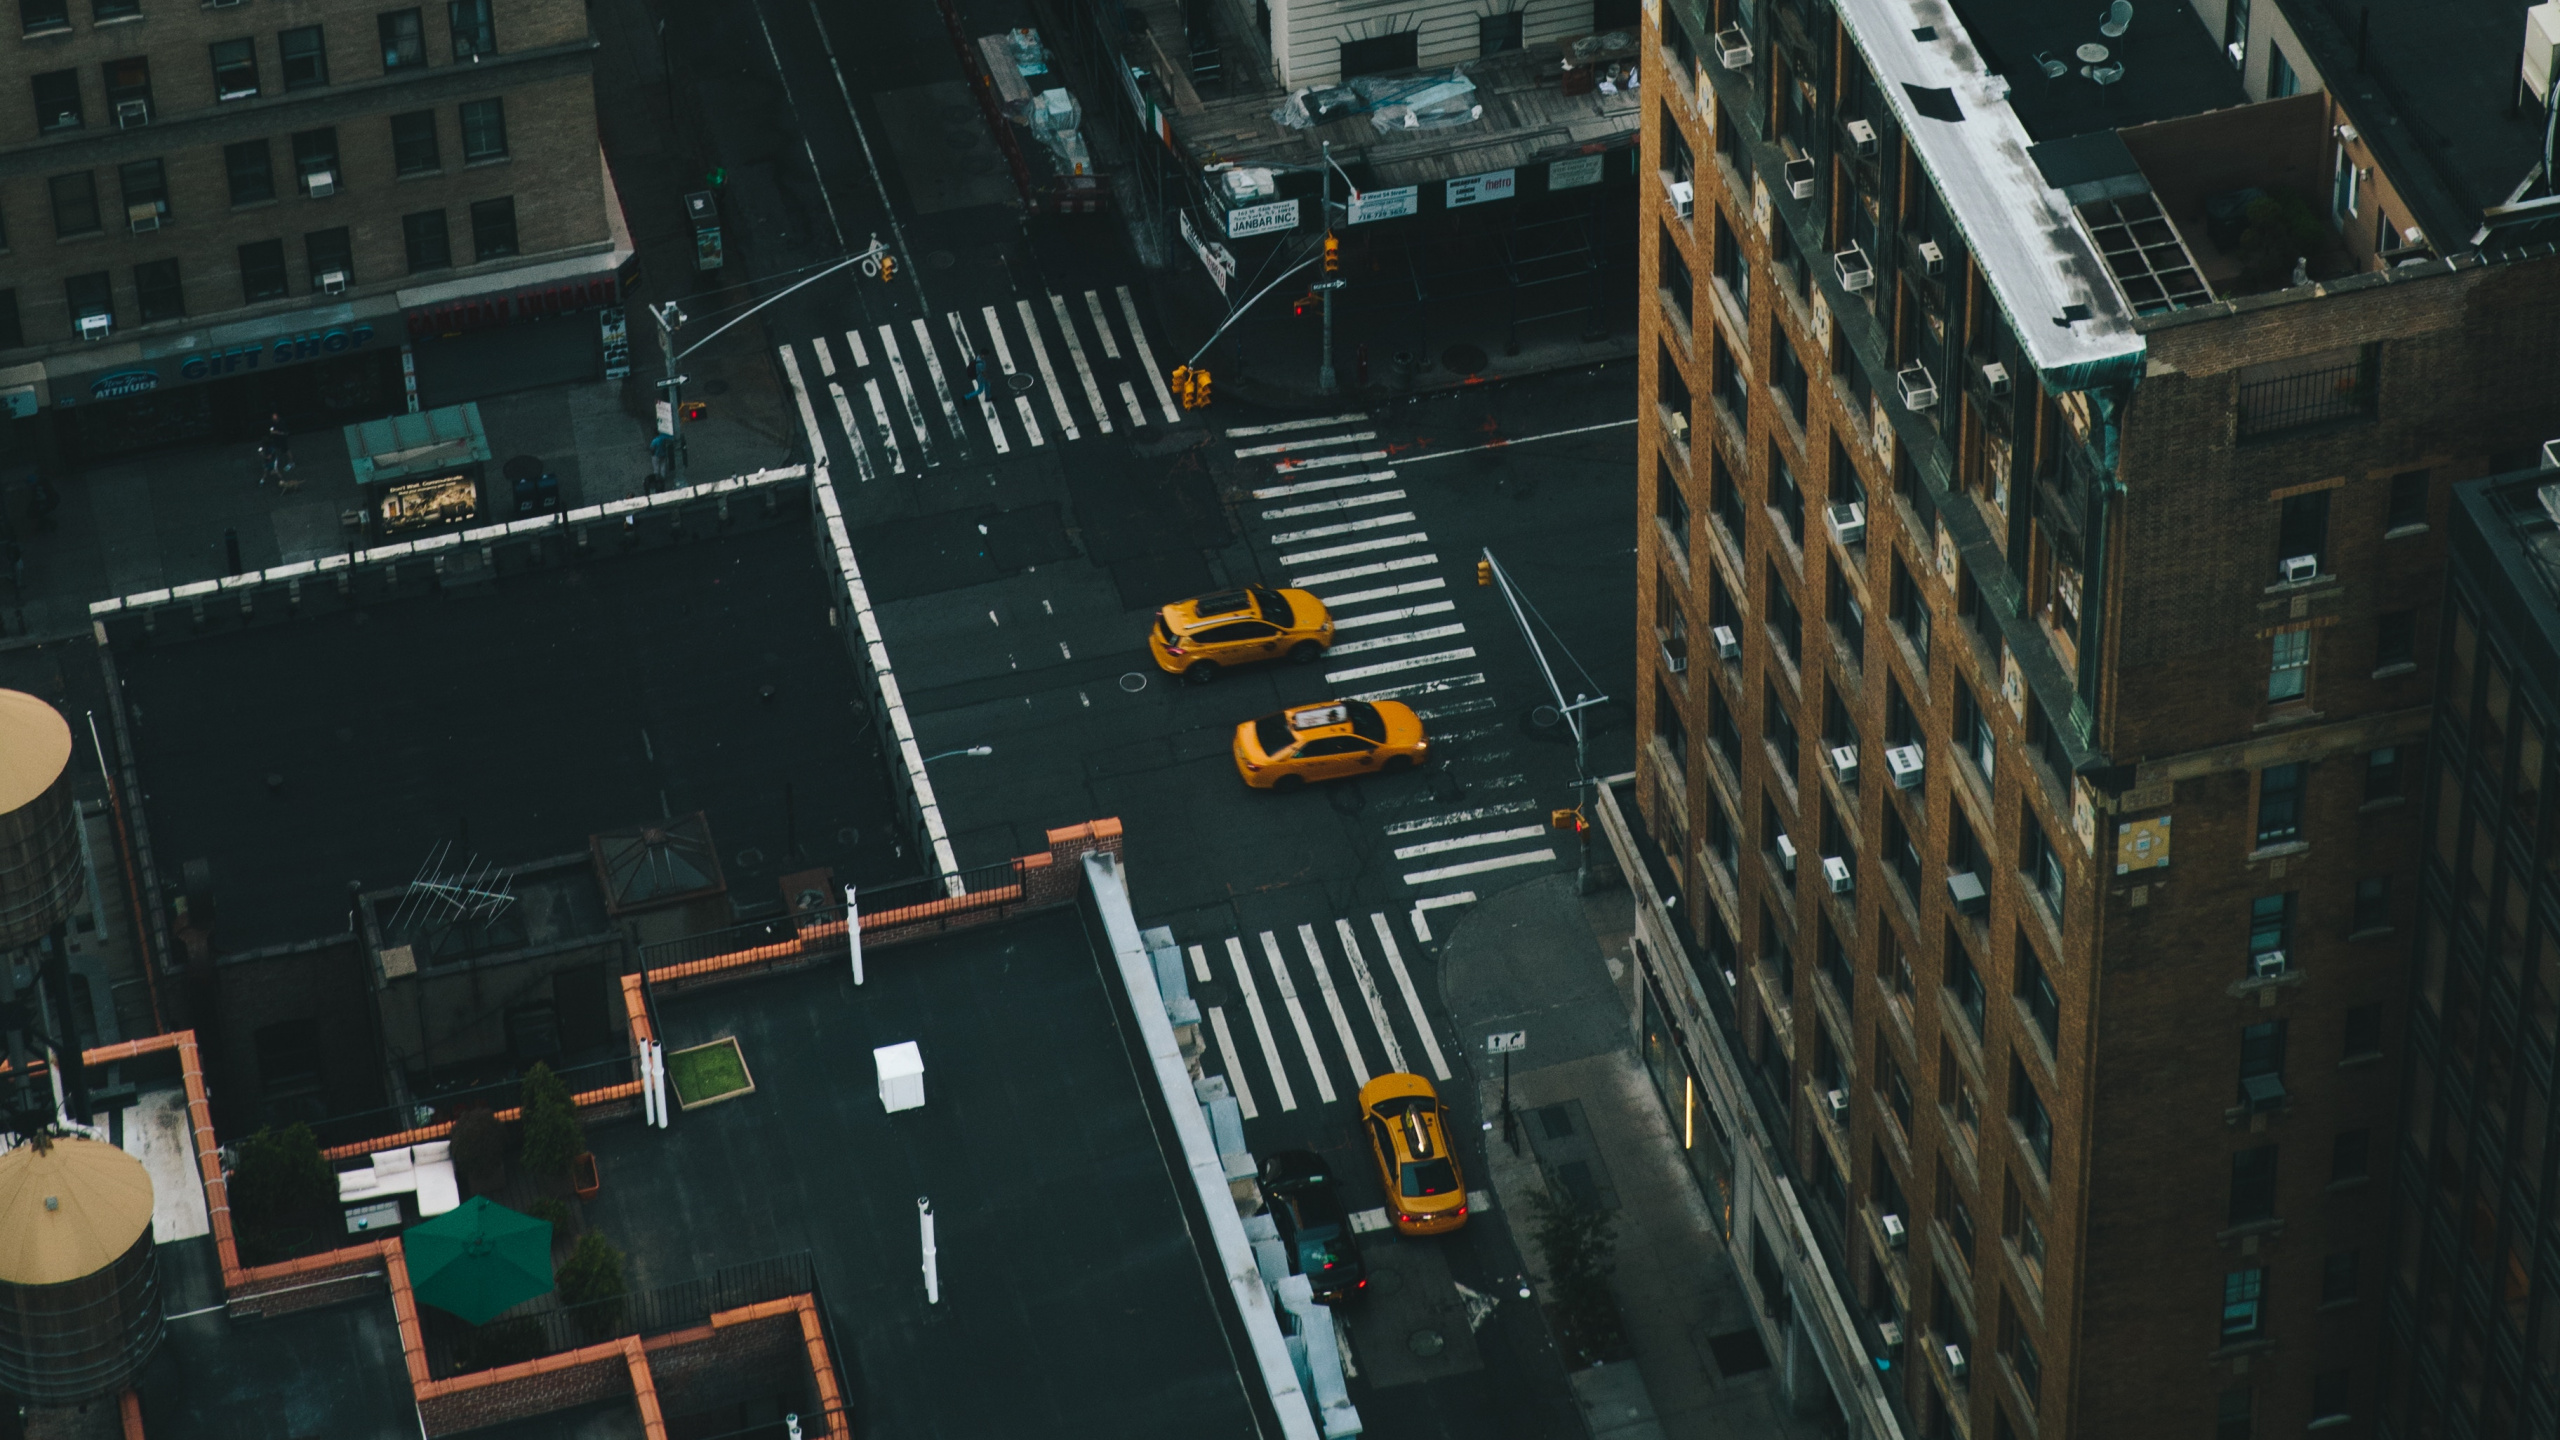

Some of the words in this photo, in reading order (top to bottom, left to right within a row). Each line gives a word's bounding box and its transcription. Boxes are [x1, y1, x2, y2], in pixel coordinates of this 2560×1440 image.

[1485, 178, 1511, 191] metro
[1233, 216, 1272, 232] JANBAR
[1275, 213, 1296, 224] INC.
[408, 297, 509, 335] CAMERAS
[518, 277, 615, 317] LUGGAGE
[181, 345, 263, 380] GIFT
[273, 324, 374, 364] SHOP
[95, 379, 158, 399] ATTITUDE
[389, 485, 406, 493] Don't
